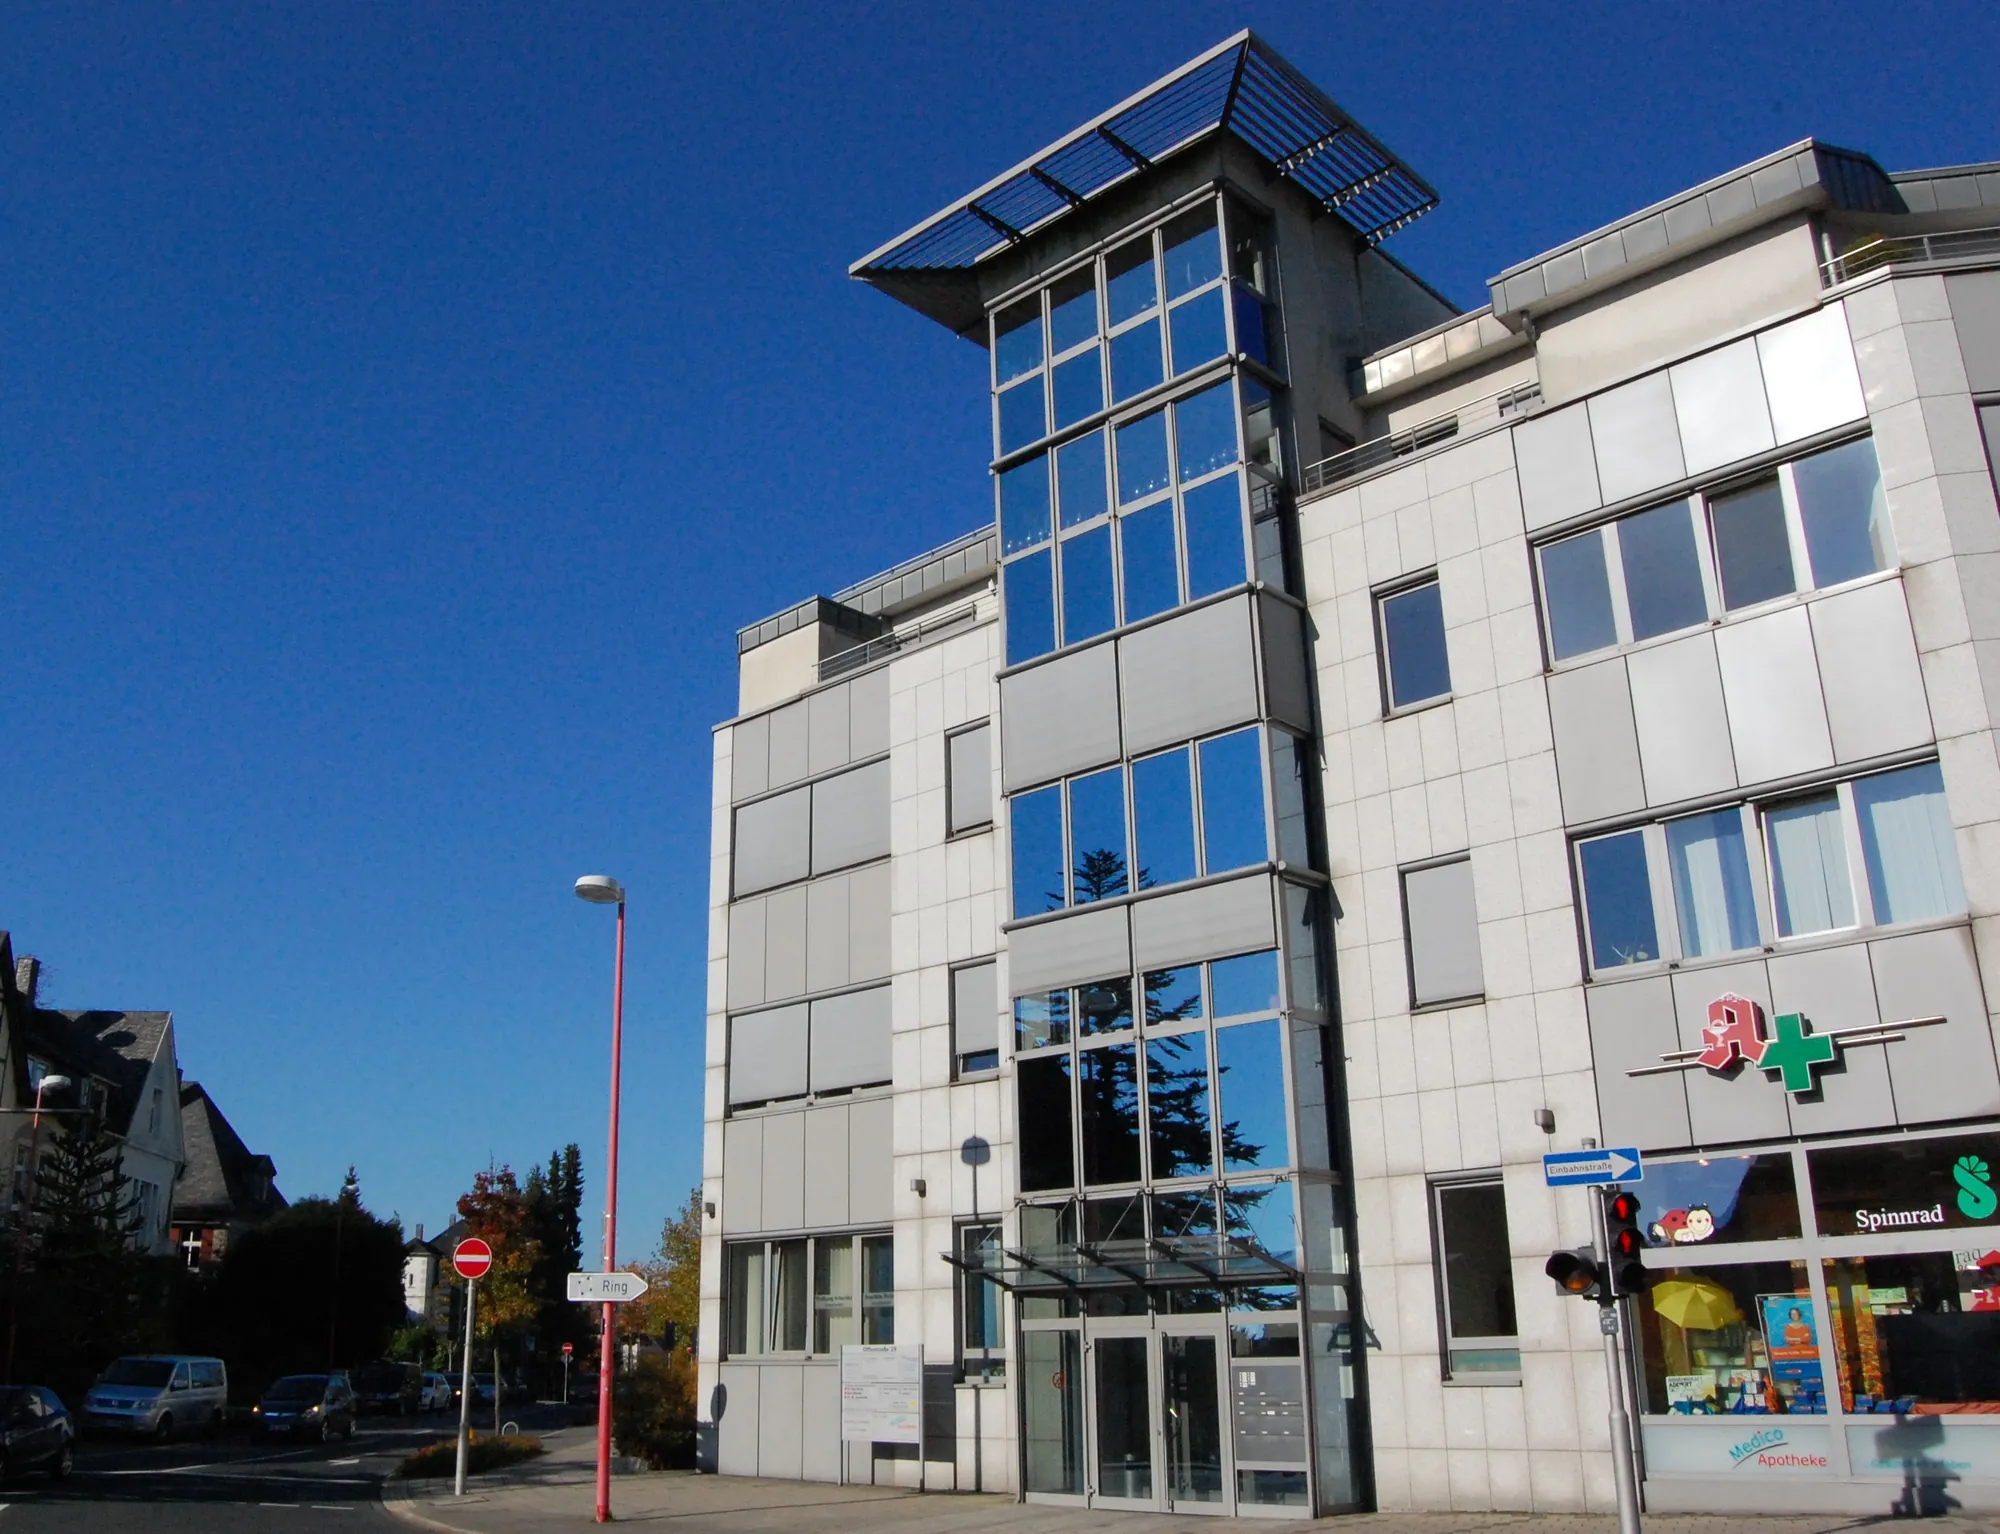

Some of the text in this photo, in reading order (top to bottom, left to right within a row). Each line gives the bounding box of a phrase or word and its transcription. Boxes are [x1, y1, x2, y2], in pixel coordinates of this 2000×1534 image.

[1549, 1162, 1613, 1175] Einbahnstraße
[1855, 1203, 1944, 1231] Spinnrad
[602, 1279, 628, 1295] Ring
[1728, 1428, 1784, 1462] Medico
[1758, 1453, 1827, 1468] Apotheke
